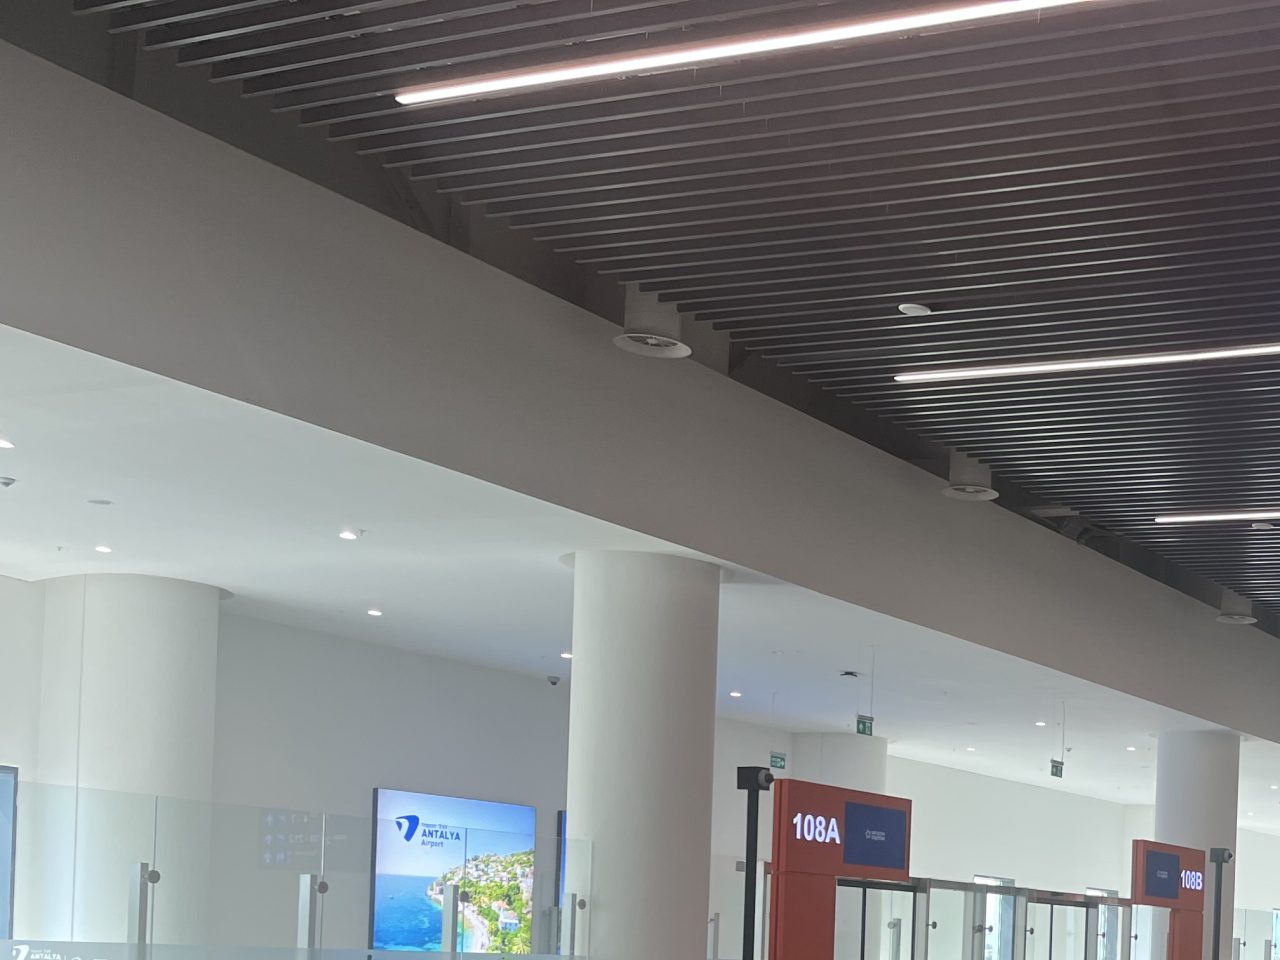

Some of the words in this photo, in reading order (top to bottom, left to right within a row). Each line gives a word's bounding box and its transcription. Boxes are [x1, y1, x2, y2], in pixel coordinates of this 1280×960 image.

[421, 828, 461, 841] ANTALYA
[792, 812, 841, 845] 108A
[421, 838, 444, 848] Airport
[1180, 869, 1203, 891] 108B
[30, 953, 62, 960] ANTALYA
